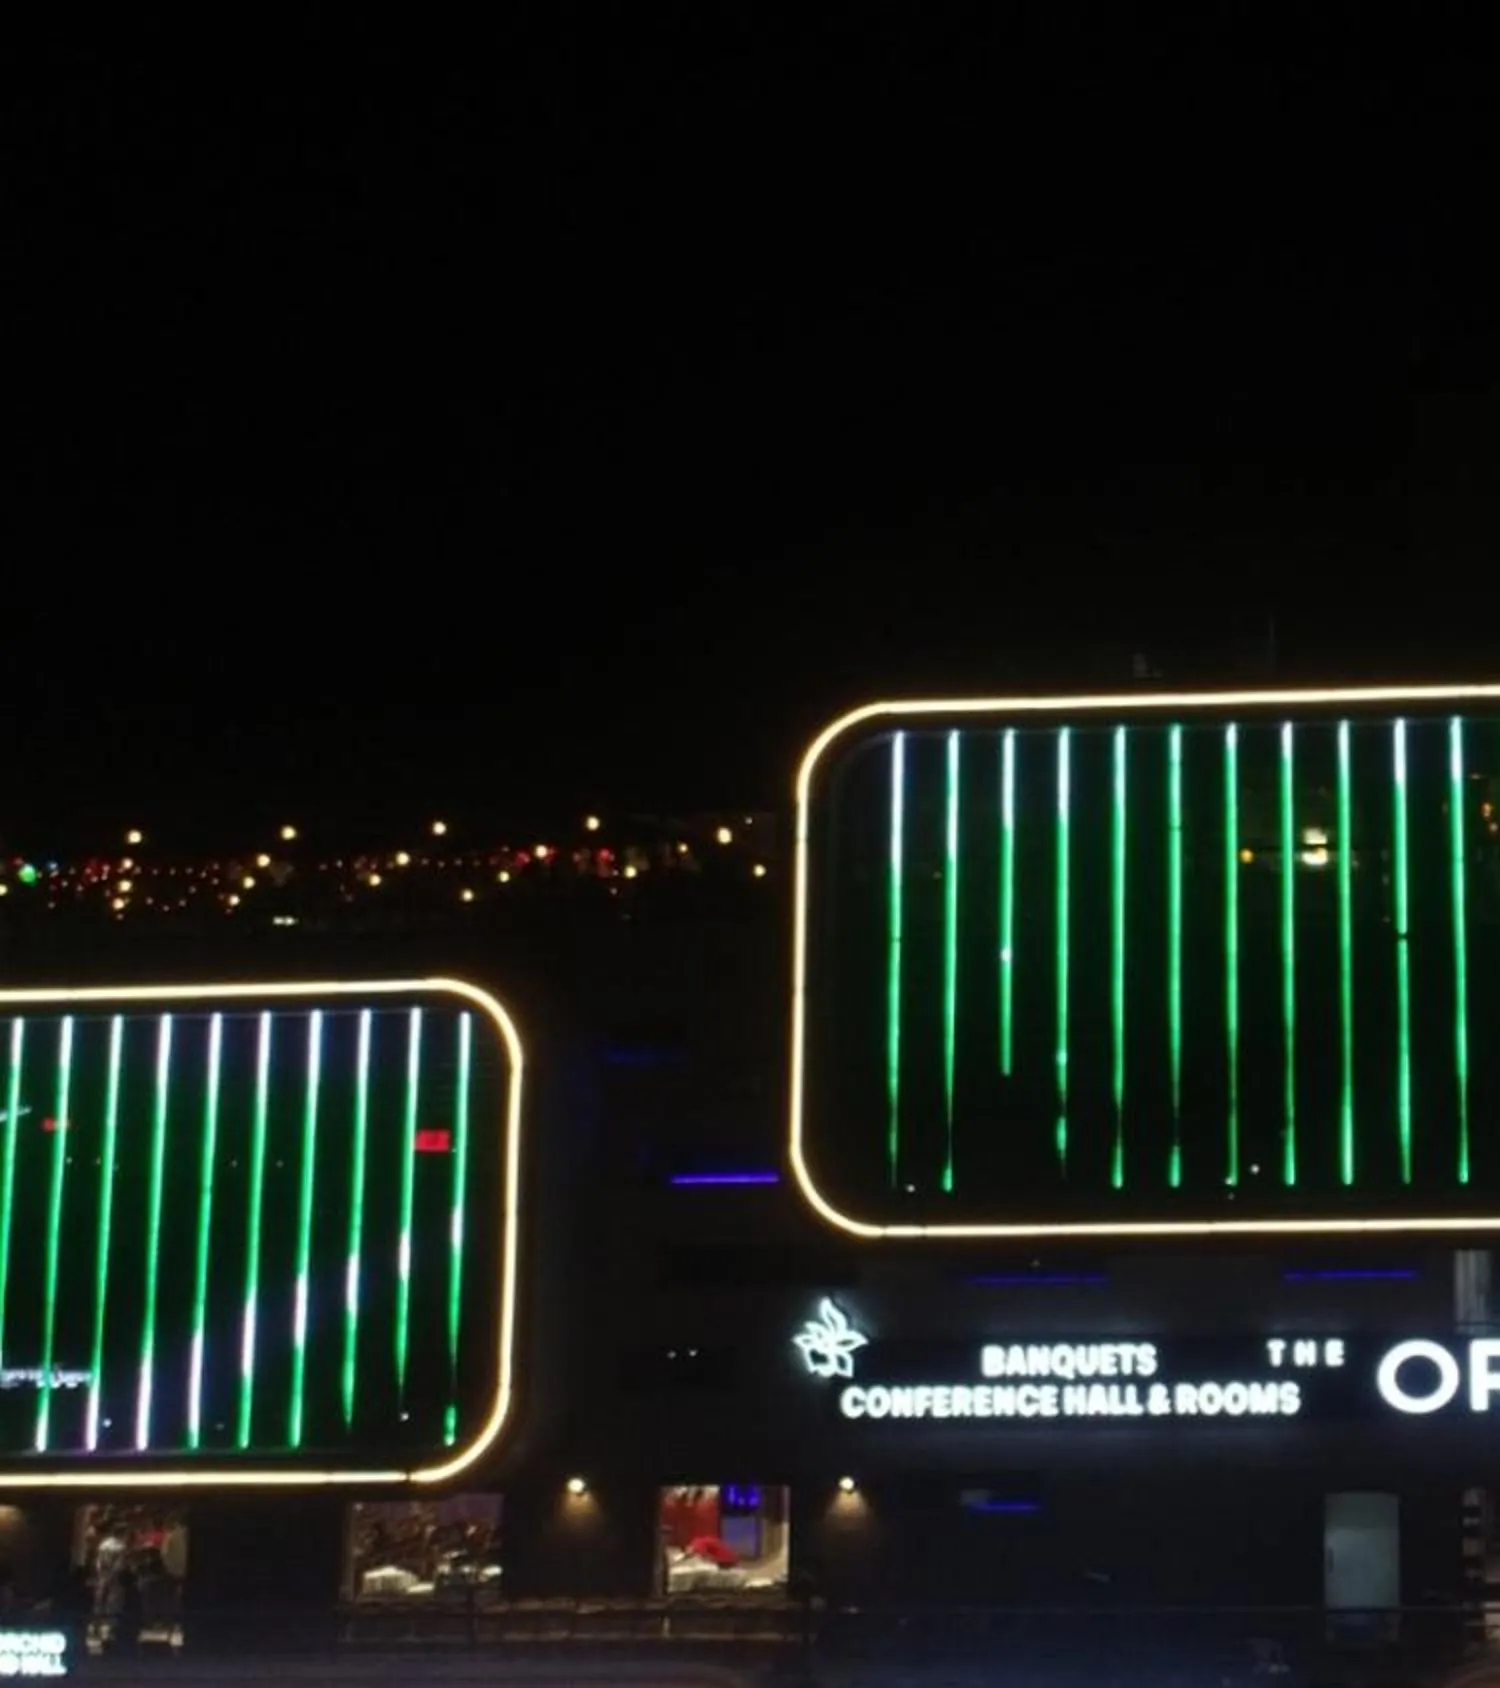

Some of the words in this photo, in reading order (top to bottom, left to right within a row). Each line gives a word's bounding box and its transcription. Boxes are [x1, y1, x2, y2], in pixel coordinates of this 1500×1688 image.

[981, 1343, 1158, 1380] BANQUETS
[1267, 1338, 1345, 1366] THE
[841, 1384, 1059, 1419] CONFERENCE
[1063, 1382, 1143, 1416] HALL
[1145, 1383, 1172, 1416] &
[1175, 1381, 1301, 1416] ROOMS
